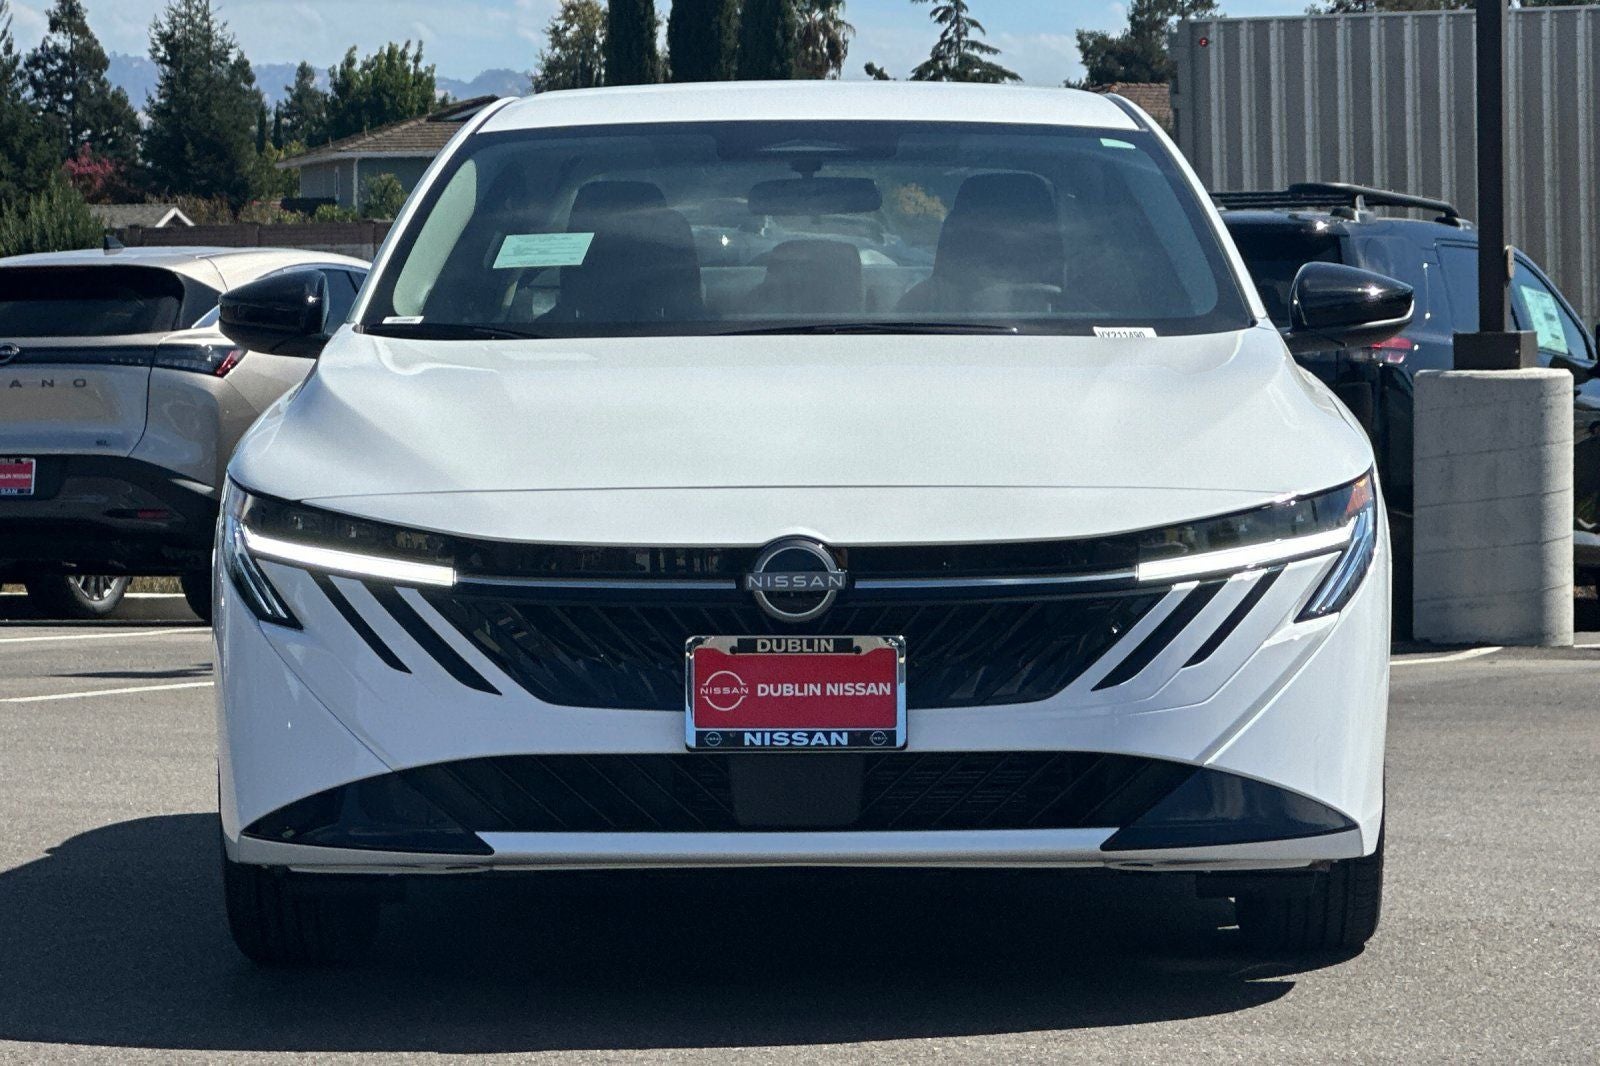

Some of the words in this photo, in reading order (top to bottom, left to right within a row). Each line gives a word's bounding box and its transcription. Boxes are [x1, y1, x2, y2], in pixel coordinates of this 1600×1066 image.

[9, 377, 87, 388] ANO
[747, 575, 843, 588] NISSAN
[756, 638, 835, 653] DUBLIN
[700, 686, 749, 695] NISSAN
[757, 683, 821, 697] DUBLIN
[826, 682, 892, 696] NISSAN
[743, 731, 849, 746] NISSAN
